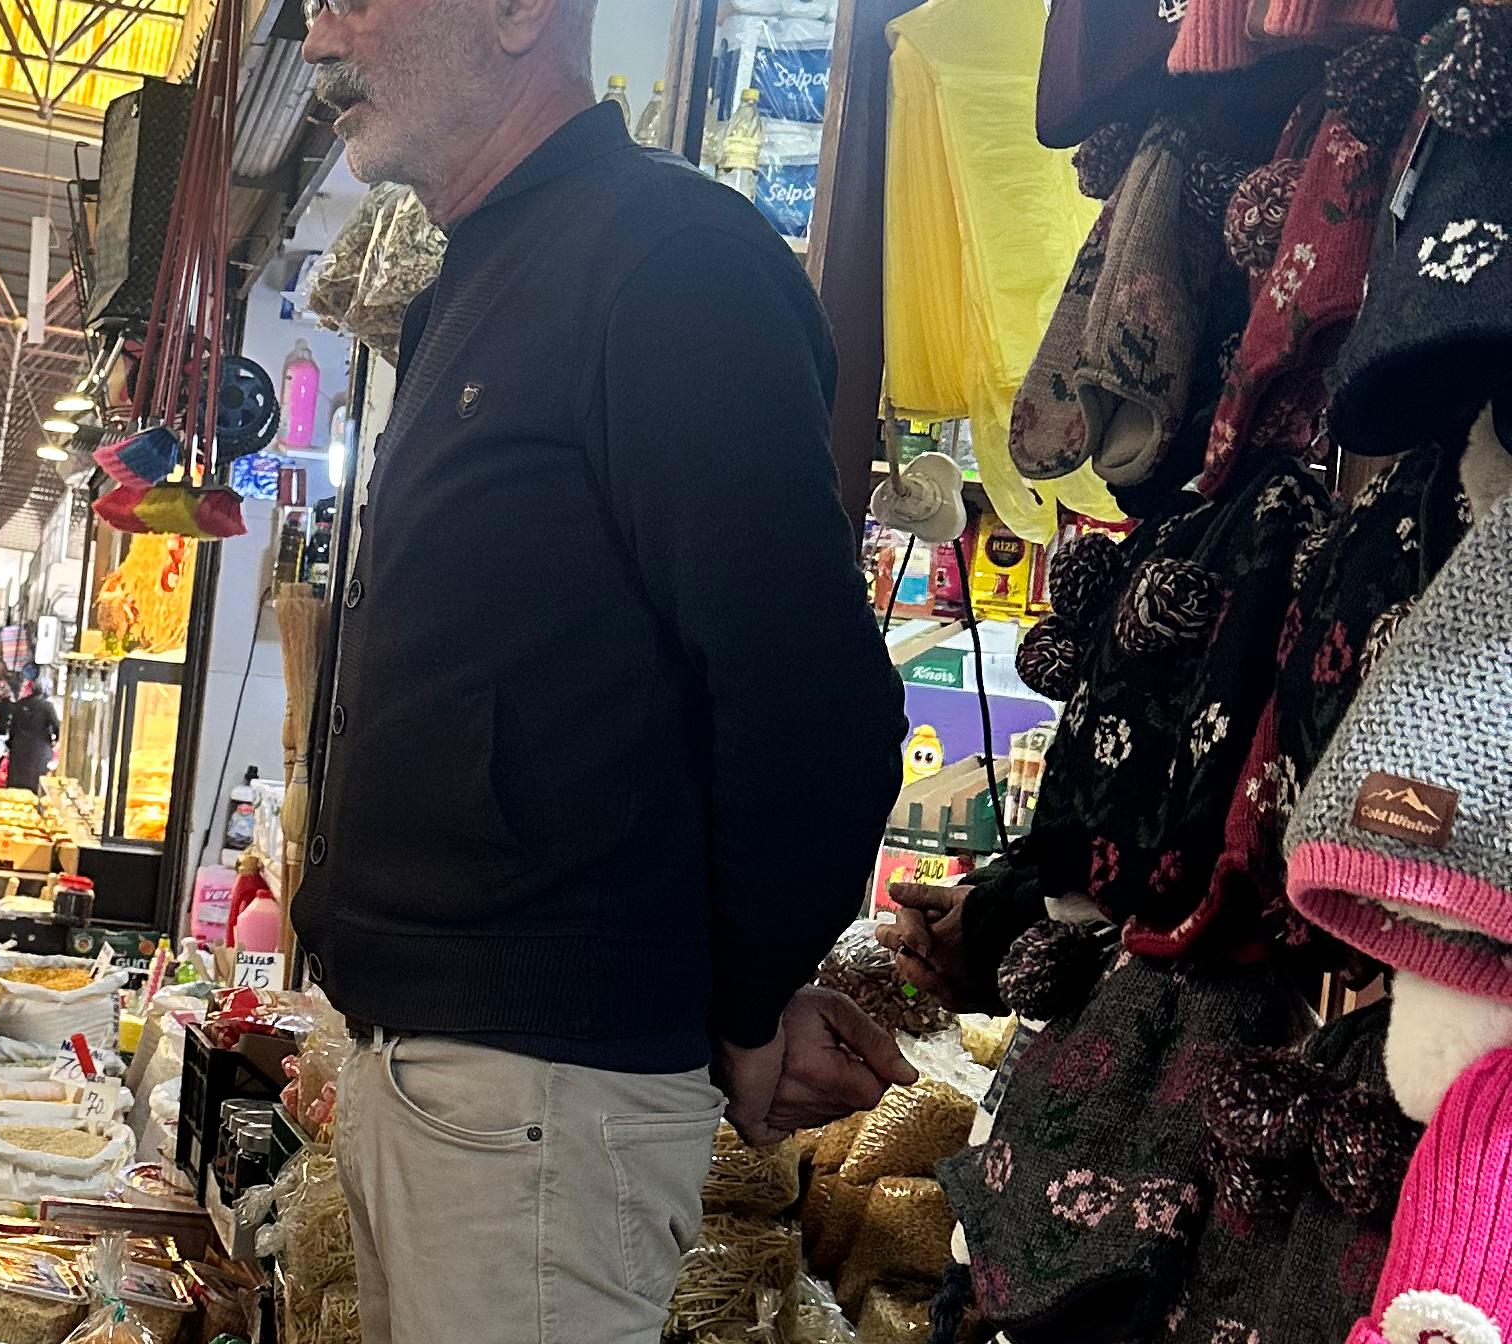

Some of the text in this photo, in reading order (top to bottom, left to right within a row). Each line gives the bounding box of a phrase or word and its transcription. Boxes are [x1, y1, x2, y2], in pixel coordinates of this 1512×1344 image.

[911, 665, 957, 684] Knorr
[1360, 804, 1436, 836] Cold Winter
